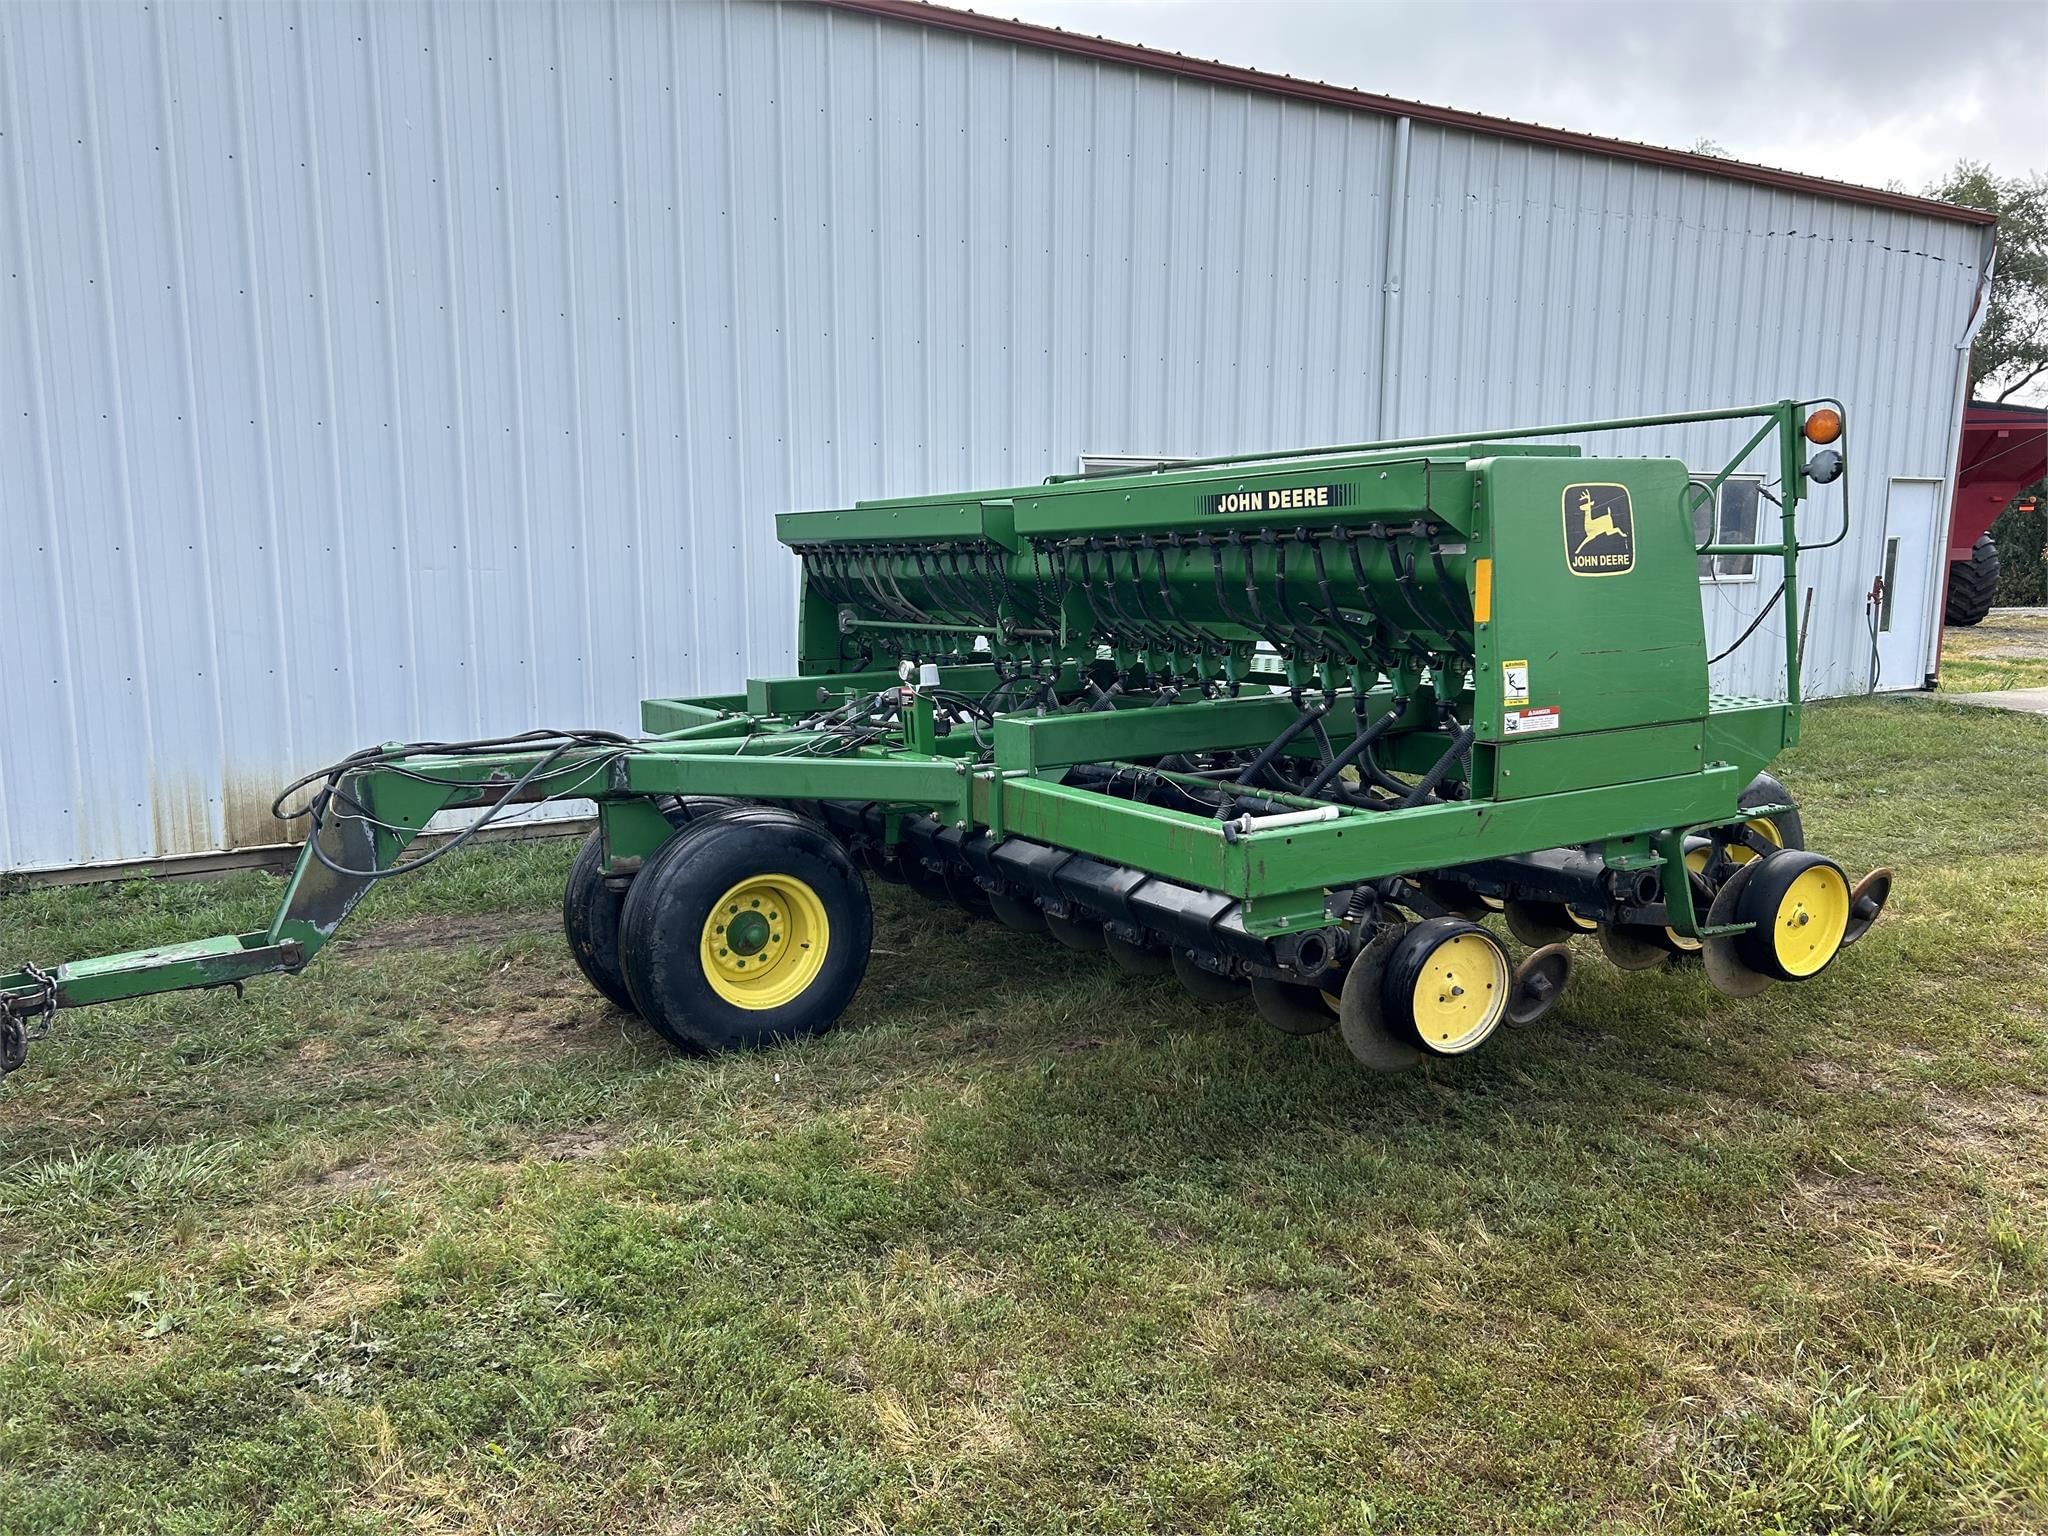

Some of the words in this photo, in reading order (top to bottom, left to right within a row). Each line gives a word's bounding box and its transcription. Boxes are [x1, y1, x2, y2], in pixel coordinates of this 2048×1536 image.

[1218, 493, 1262, 512] JOHN
[1269, 487, 1328, 509] DEERE
[1572, 555, 1598, 567] JOHN
[1600, 554, 1630, 566] DEERE
